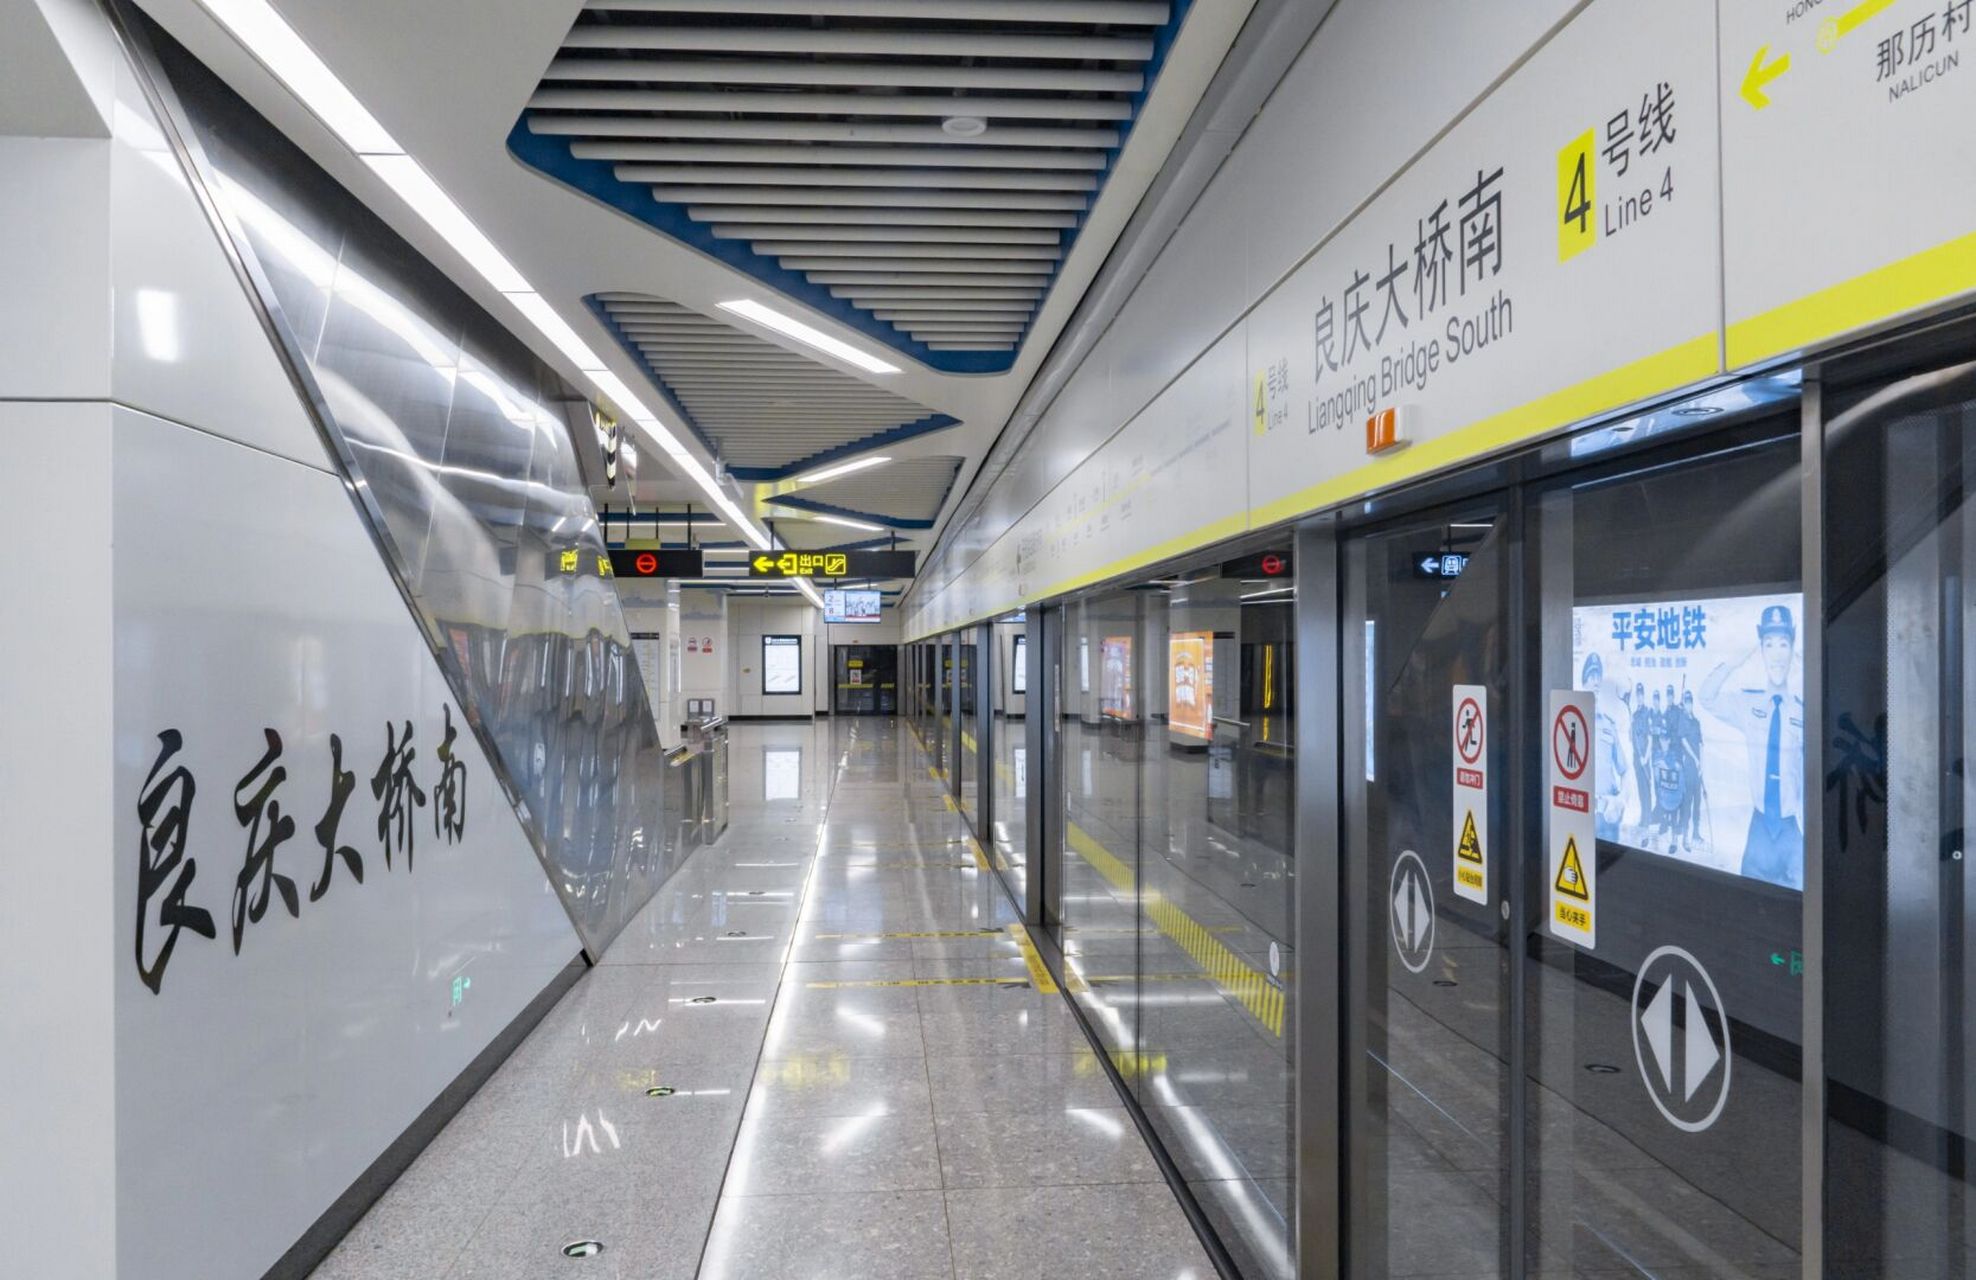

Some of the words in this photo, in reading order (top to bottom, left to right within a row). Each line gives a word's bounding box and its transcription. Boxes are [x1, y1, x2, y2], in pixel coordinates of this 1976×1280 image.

[1876, 0, 1975, 82] 那历村
[1889, 51, 1959, 103] NALICUN
[1564, 152, 1592, 234] 4
[1601, 82, 1676, 178] 号线
[1605, 188, 1653, 237] Line
[1660, 165, 1674, 202] 4
[1314, 166, 1505, 385] 良庆大桥南
[1308, 373, 1377, 435] Liangqing
[1381, 339, 1440, 399] Bridge
[1446, 289, 1513, 363] South
[800, 554, 823, 566] 出口
[1611, 604, 1706, 651] 平安地铁
[135, 701, 467, 996] 良庆大桥南
